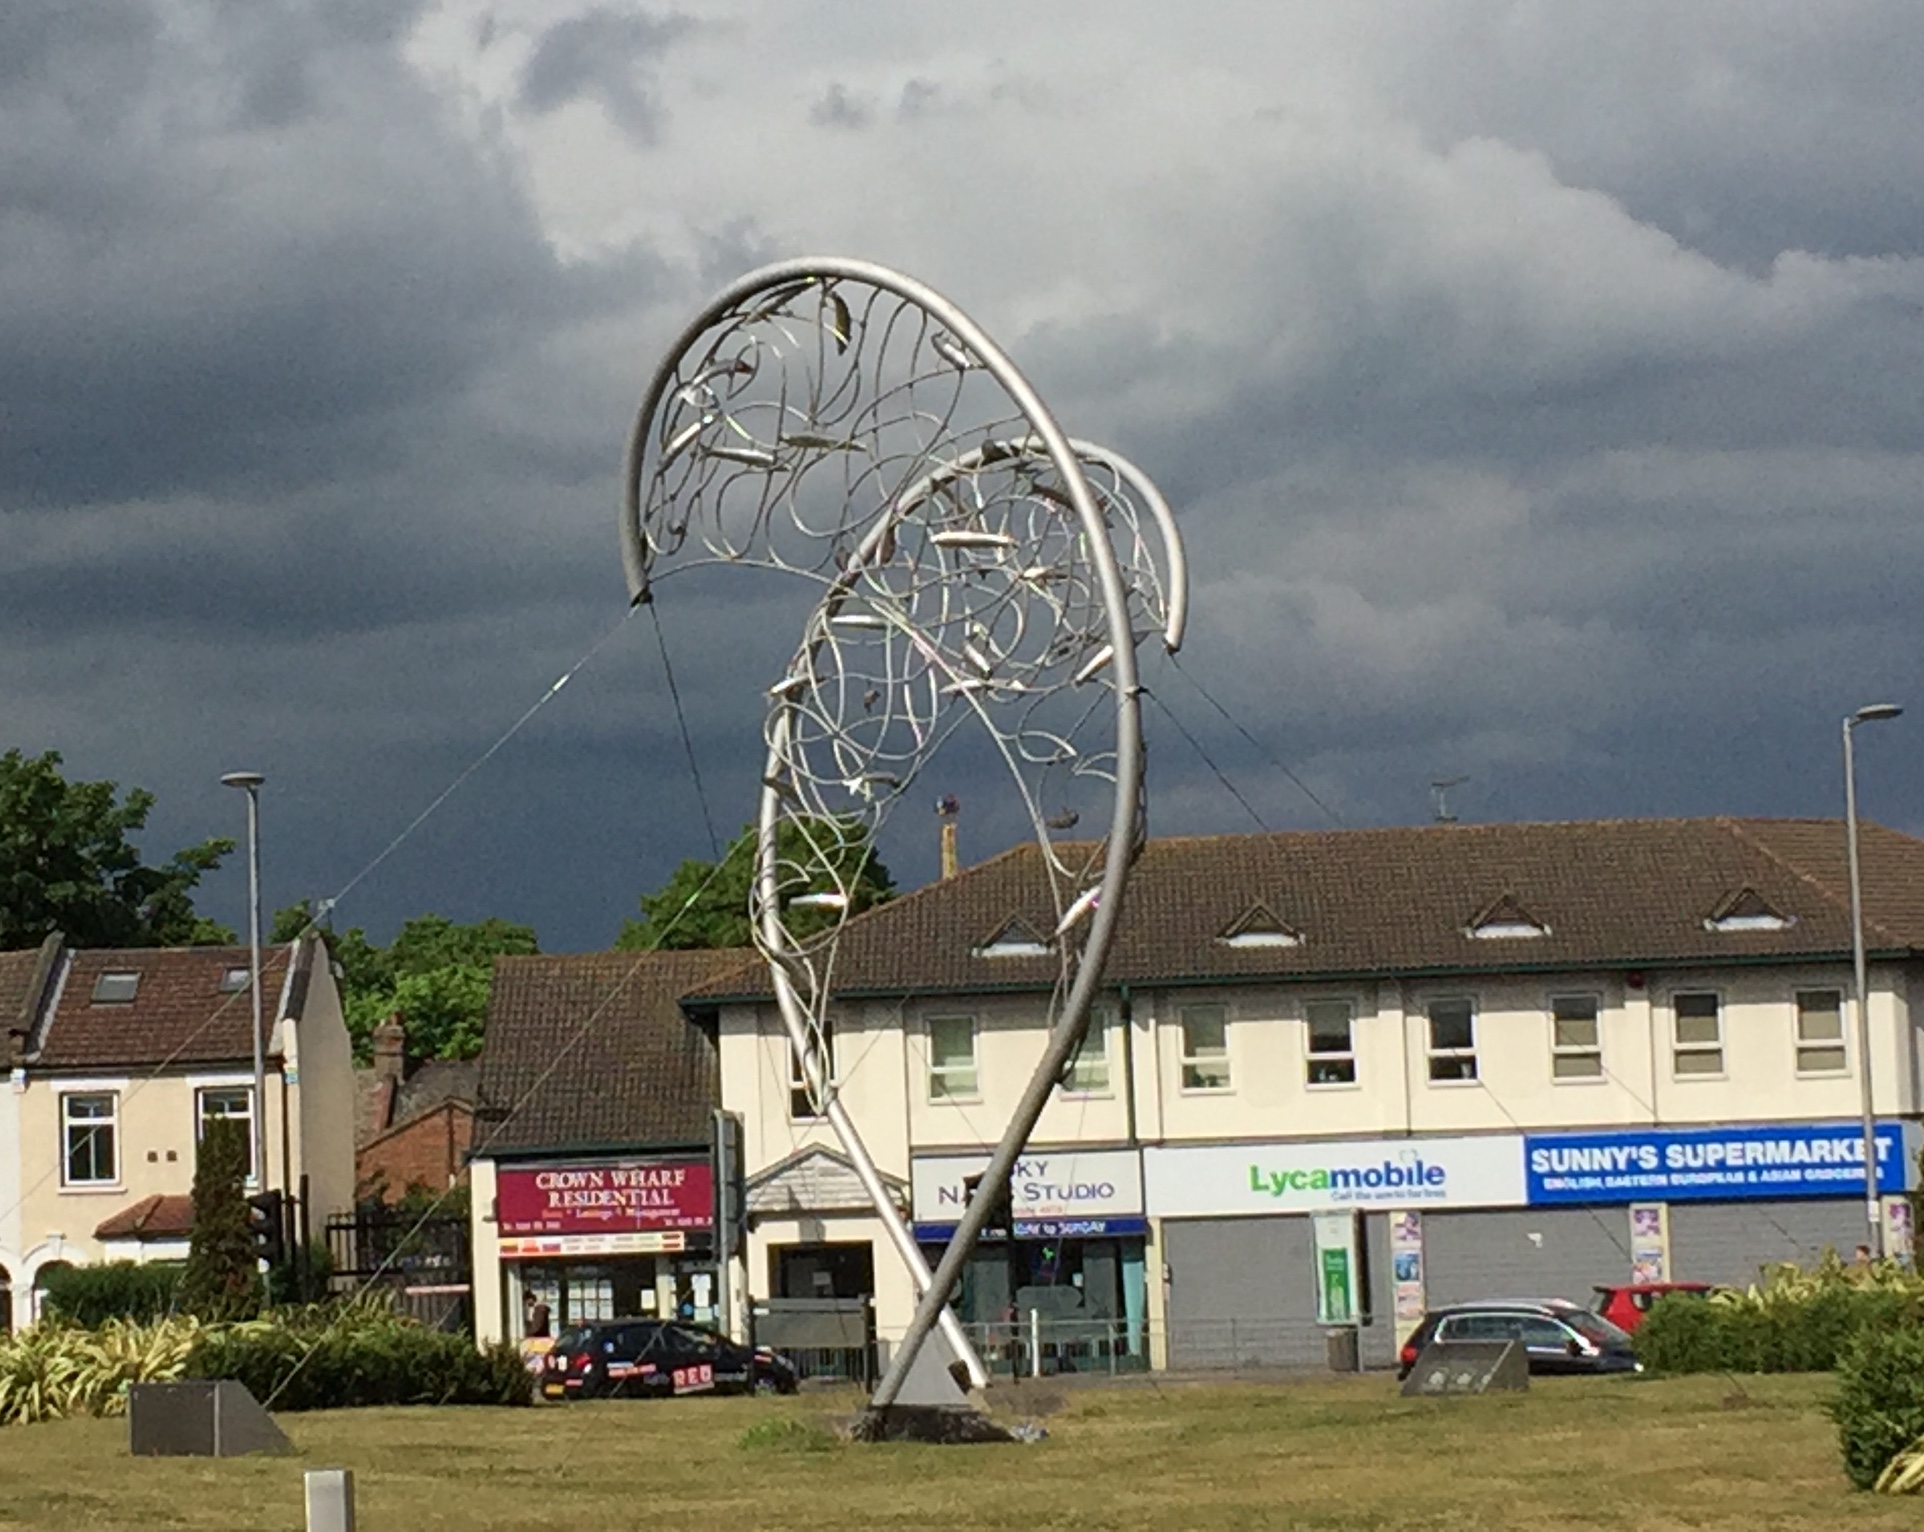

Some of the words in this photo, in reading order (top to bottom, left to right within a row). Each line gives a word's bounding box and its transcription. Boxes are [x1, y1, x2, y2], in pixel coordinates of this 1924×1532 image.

[1531, 1145, 1659, 1173] SUNNY'S
[1665, 1137, 1893, 1168] SUPERMARKET
[535, 1172, 604, 1190] CROWN
[611, 1168, 685, 1187] WHARF
[1011, 1161, 1048, 1178] KY
[1250, 1160, 1446, 1197] Lycamobile
[549, 1188, 675, 1208] RESIDENTIAL
[1024, 1182, 1115, 1201] STUDIO
